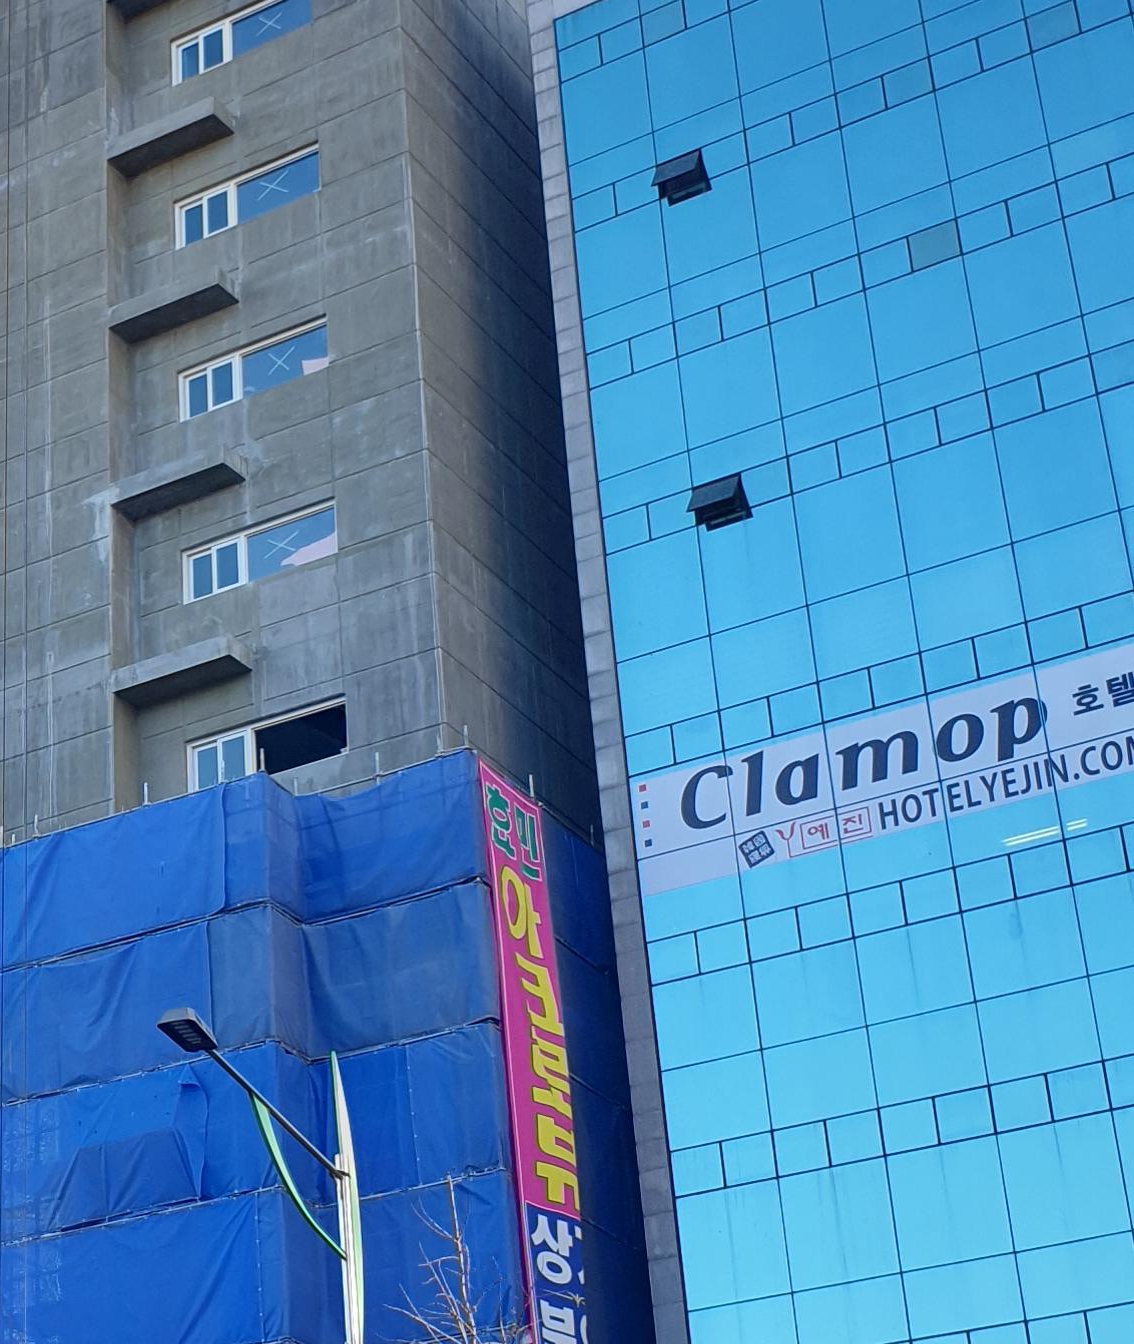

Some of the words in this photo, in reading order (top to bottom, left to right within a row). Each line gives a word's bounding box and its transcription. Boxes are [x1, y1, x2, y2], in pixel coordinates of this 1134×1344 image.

[681, 697, 1048, 830] Clamop
[485, 783, 542, 881] 효민
[531, 1214, 585, 1285] 상
